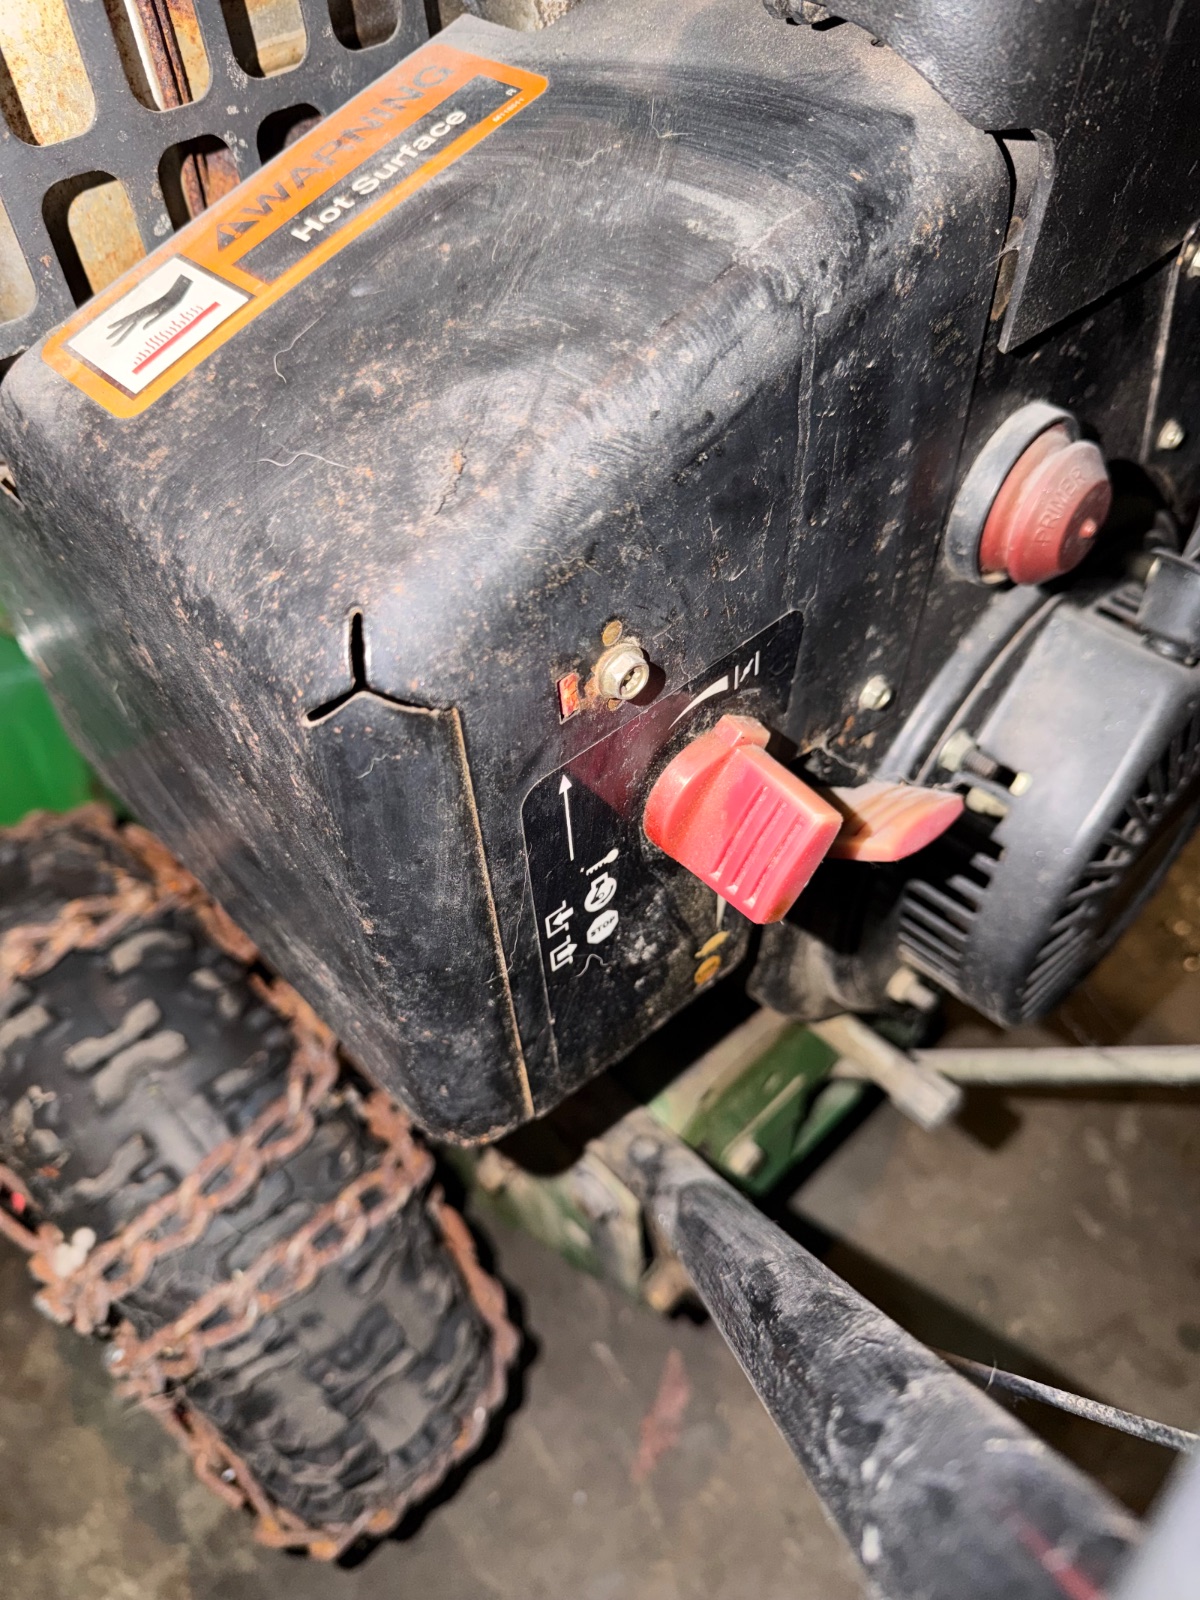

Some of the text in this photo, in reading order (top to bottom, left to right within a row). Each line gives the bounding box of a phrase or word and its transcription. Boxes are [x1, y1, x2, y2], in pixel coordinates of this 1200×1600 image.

[240, 65, 453, 216] WARNING
[291, 110, 467, 242] Hot Surface
[1034, 466, 1087, 546] PRIMER
[590, 915, 616, 938] STOP
